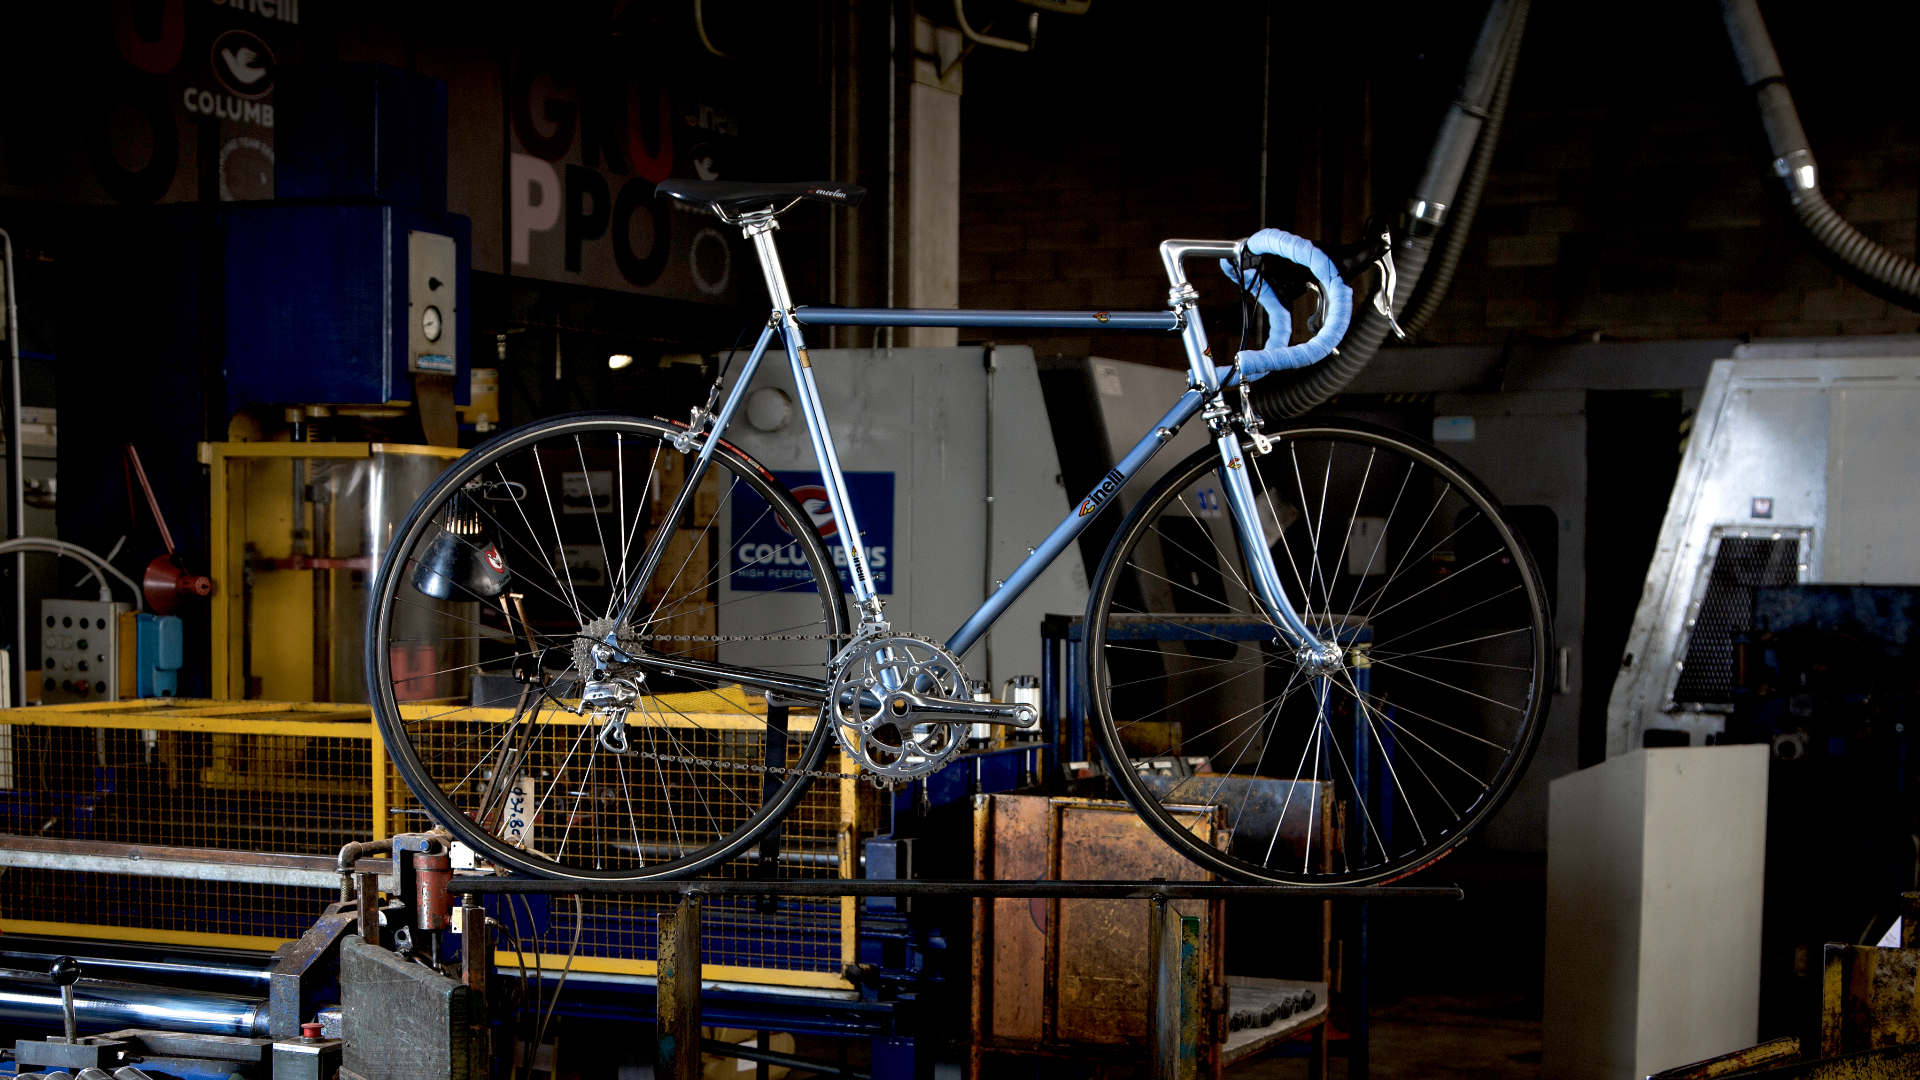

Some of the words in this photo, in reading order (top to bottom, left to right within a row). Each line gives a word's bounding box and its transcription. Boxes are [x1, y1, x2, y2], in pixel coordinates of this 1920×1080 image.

[1079, 467, 1125, 517] Cinelli
[738, 542, 886, 568] COLUBS
[738, 568, 765, 578] HIGH
